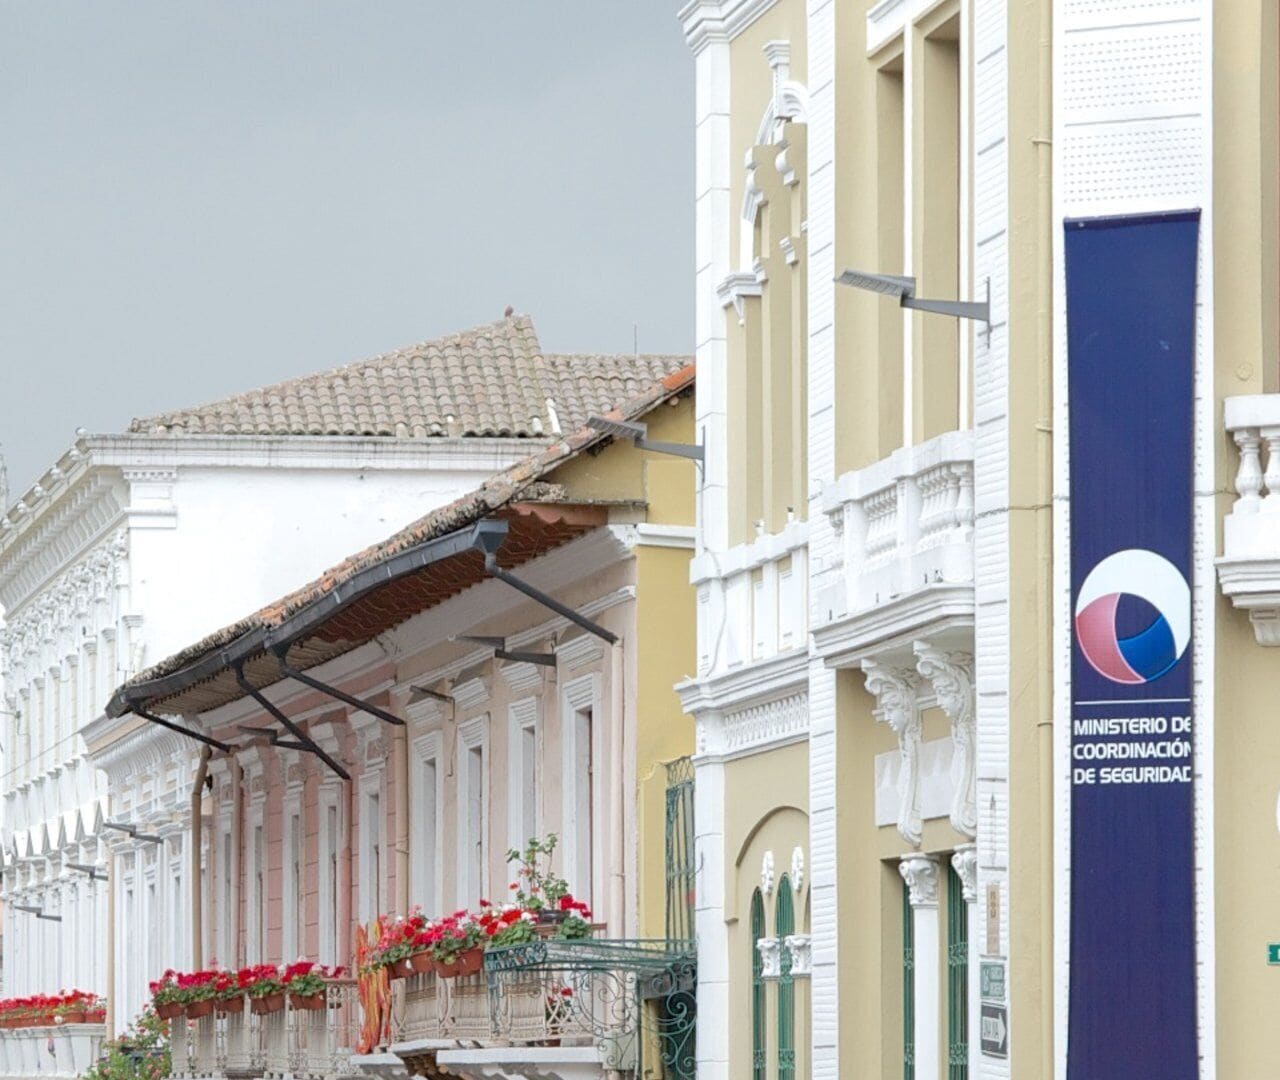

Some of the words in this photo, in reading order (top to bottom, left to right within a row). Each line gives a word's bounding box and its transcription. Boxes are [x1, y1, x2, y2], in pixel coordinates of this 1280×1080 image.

[1074, 717, 1167, 735] MINISTERIO
[1171, 716, 1191, 733] DE
[1073, 737, 1191, 760] COORDINACIÓN
[1074, 768, 1096, 784] DE
[1100, 766, 1191, 784] SEGURIDAD
